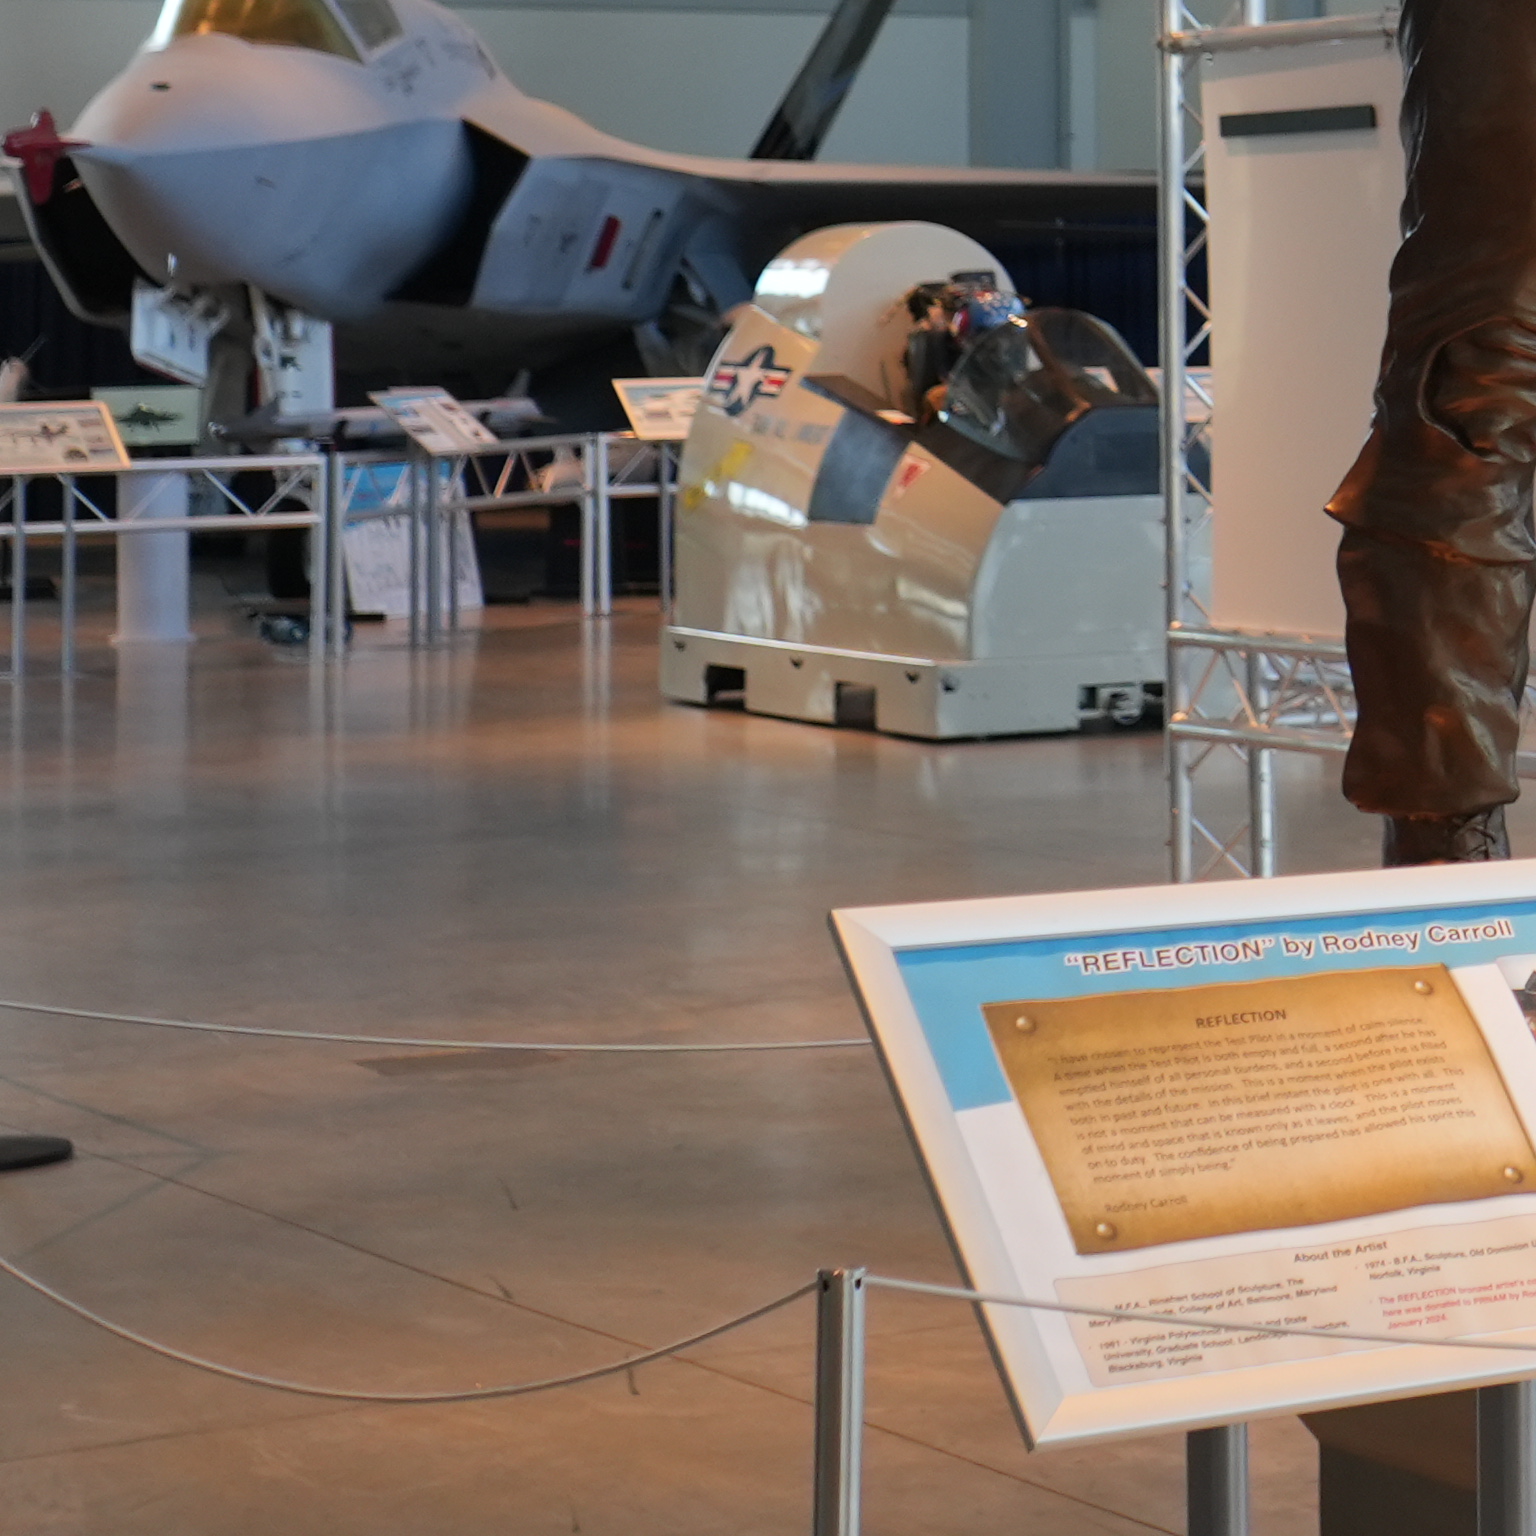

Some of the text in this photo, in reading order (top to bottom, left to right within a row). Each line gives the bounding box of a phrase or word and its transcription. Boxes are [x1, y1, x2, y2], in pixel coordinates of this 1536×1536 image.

[1323, 931, 1418, 954] Rodney
[1427, 920, 1512, 943] Carroll
[1196, 1010, 1287, 1028] REFLECTION
[1106, 1194, 1187, 1213] Rodney Carroll
[1293, 1241, 1387, 1262] About the Artist
[1365, 1260, 1385, 1269] 1974
[1487, 1242, 1529, 1254] Dominion
[1408, 1264, 1440, 1277] Virginia
[1387, 1318, 1422, 1330] January
